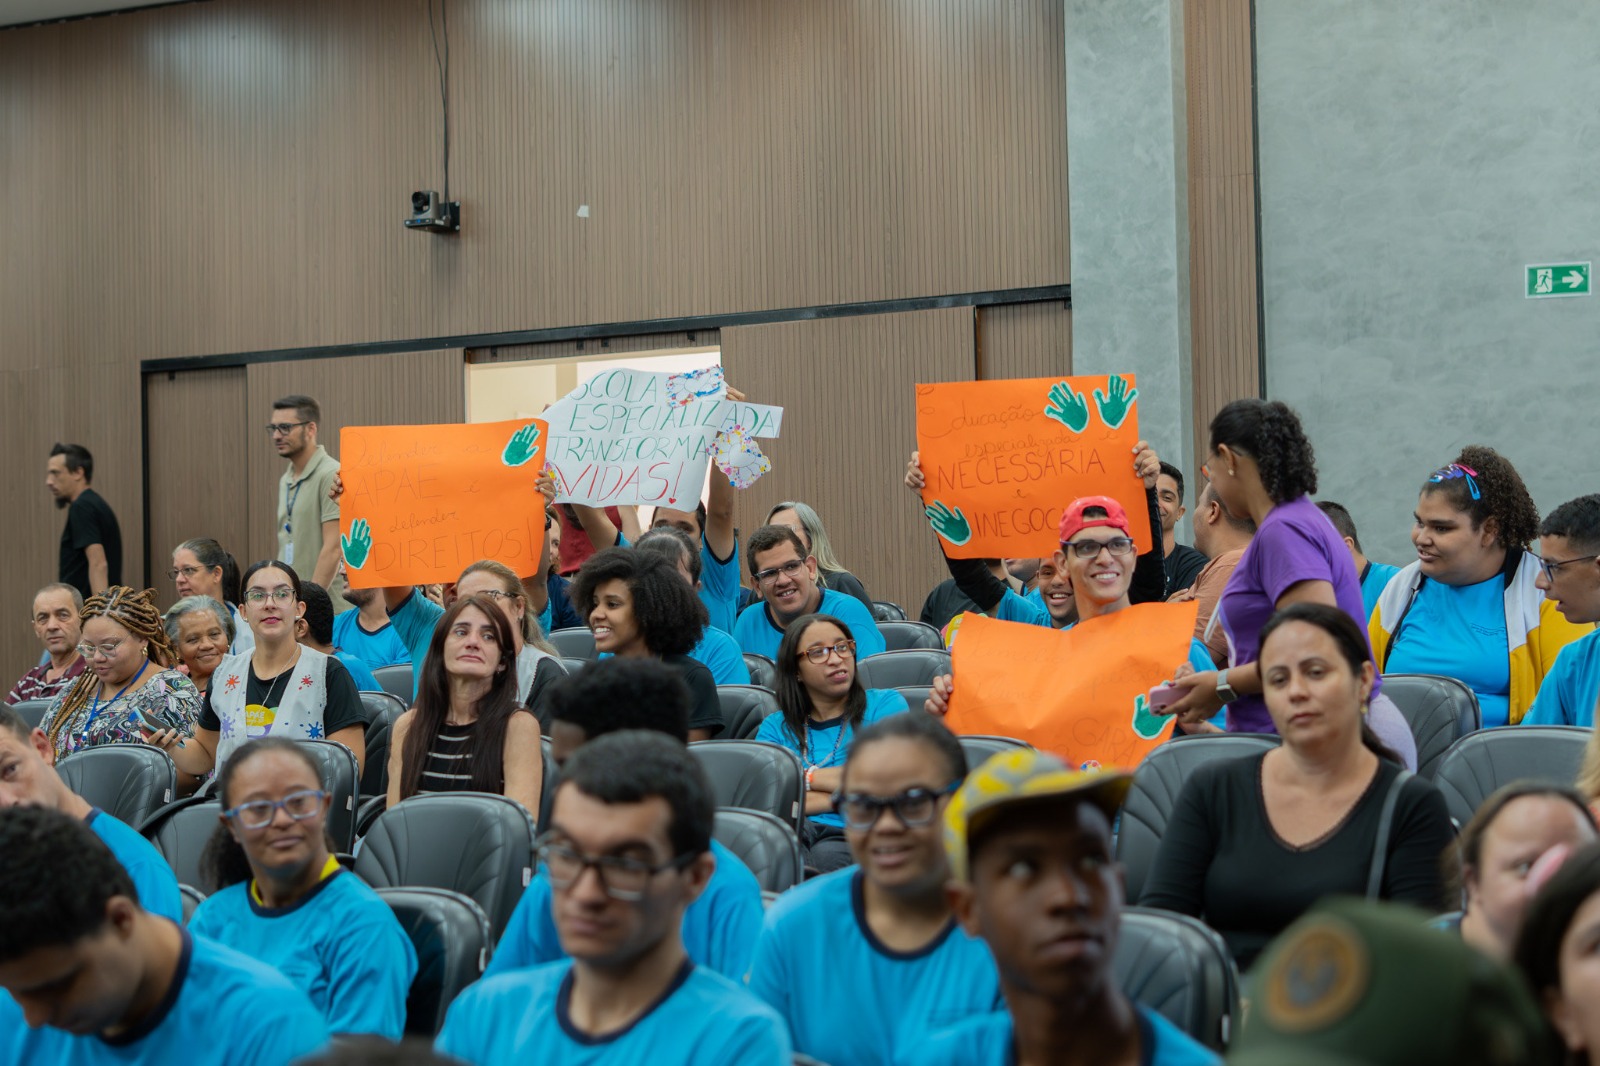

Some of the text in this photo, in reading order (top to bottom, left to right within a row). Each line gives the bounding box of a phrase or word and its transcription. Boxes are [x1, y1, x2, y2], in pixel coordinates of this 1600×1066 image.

[569, 400, 776, 436] ESPECIALIZADA
[548, 434, 708, 463] TRANSFORMA
[352, 463, 443, 510] APAE
[555, 461, 685, 505] VIDAS!
[389, 508, 460, 535] defender
[373, 517, 534, 572] DIREITOS!
